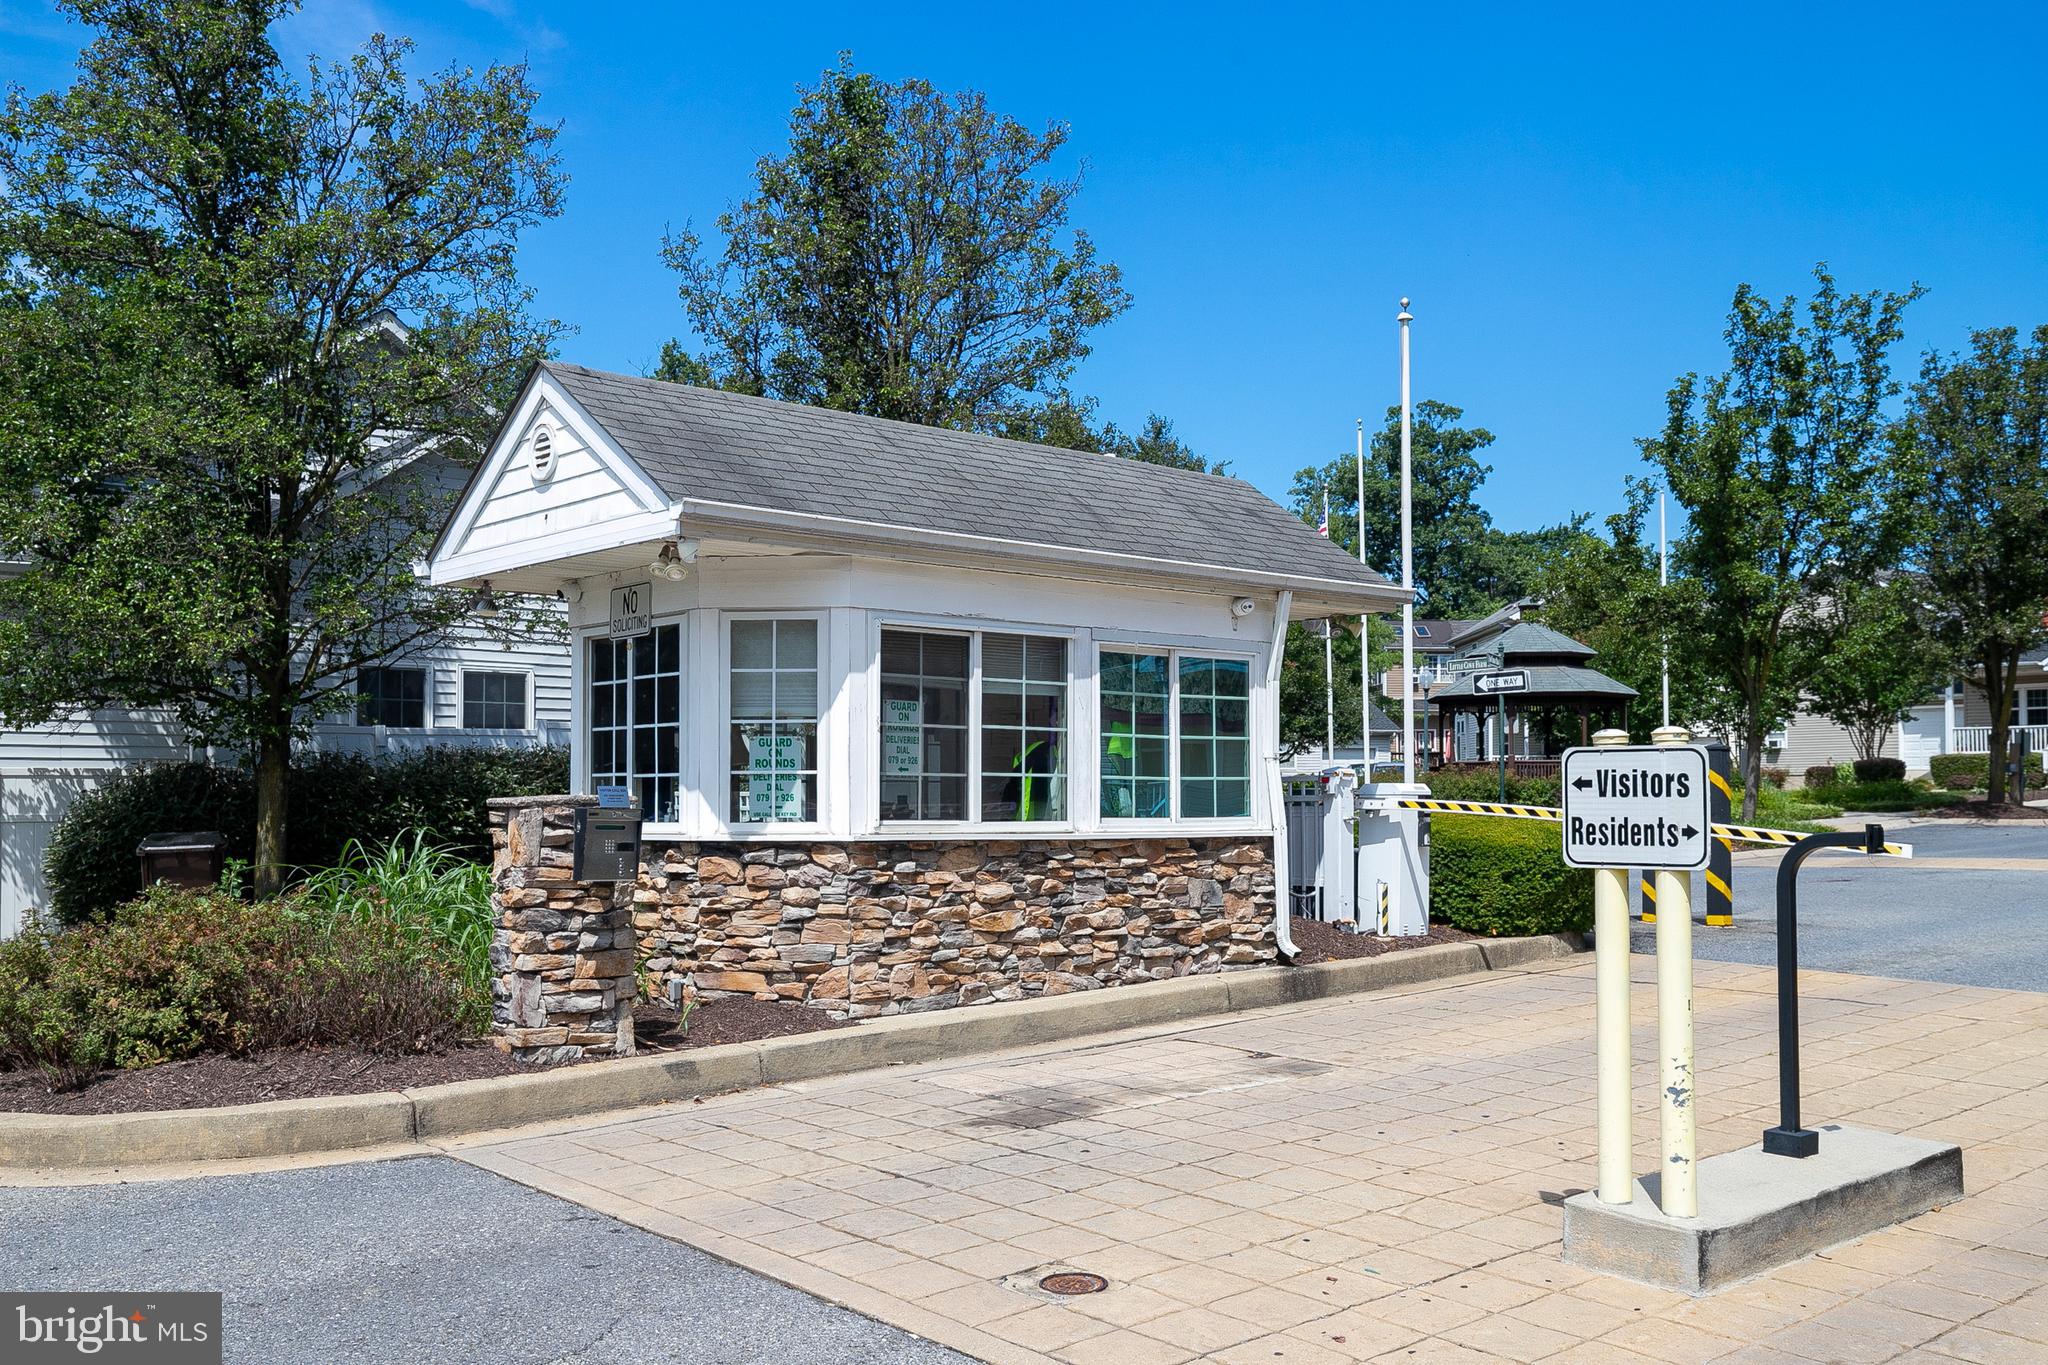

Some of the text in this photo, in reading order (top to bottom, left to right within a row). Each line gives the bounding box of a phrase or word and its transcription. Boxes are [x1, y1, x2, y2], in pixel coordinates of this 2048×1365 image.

[623, 591, 637, 615] NO
[613, 614, 647, 633] SOLICITING
[1486, 677, 1518, 687] ONE WAY
[891, 701, 917, 711] GUARD
[899, 712, 909, 721] ON
[897, 746, 910, 754] DIAL
[888, 756, 899, 764] 079
[767, 783, 784, 791] DAL
[1597, 769, 1690, 798] Visitors
[756, 794, 769, 802] 079
[781, 794, 794, 802] 926
[1571, 816, 1679, 847] Residents
